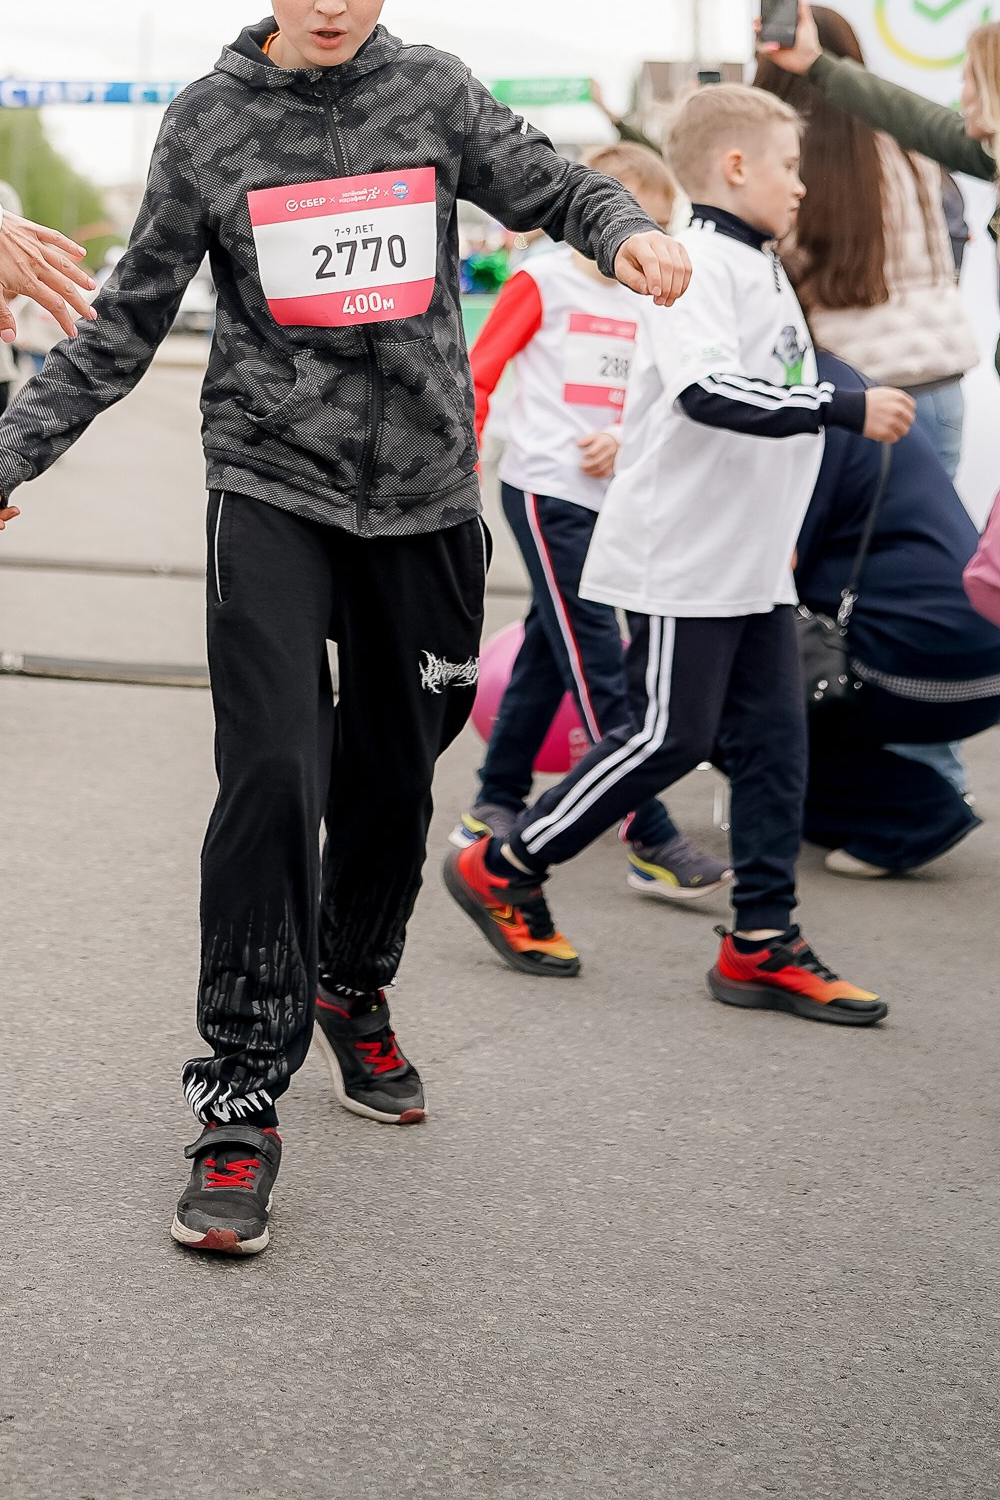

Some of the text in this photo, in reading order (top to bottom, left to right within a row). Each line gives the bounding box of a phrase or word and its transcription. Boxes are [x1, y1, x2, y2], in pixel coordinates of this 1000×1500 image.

[299, 197, 326, 209] СБЕР
[334, 224, 374, 237] 7-9 ЛЕТ
[312, 234, 407, 279] 2770
